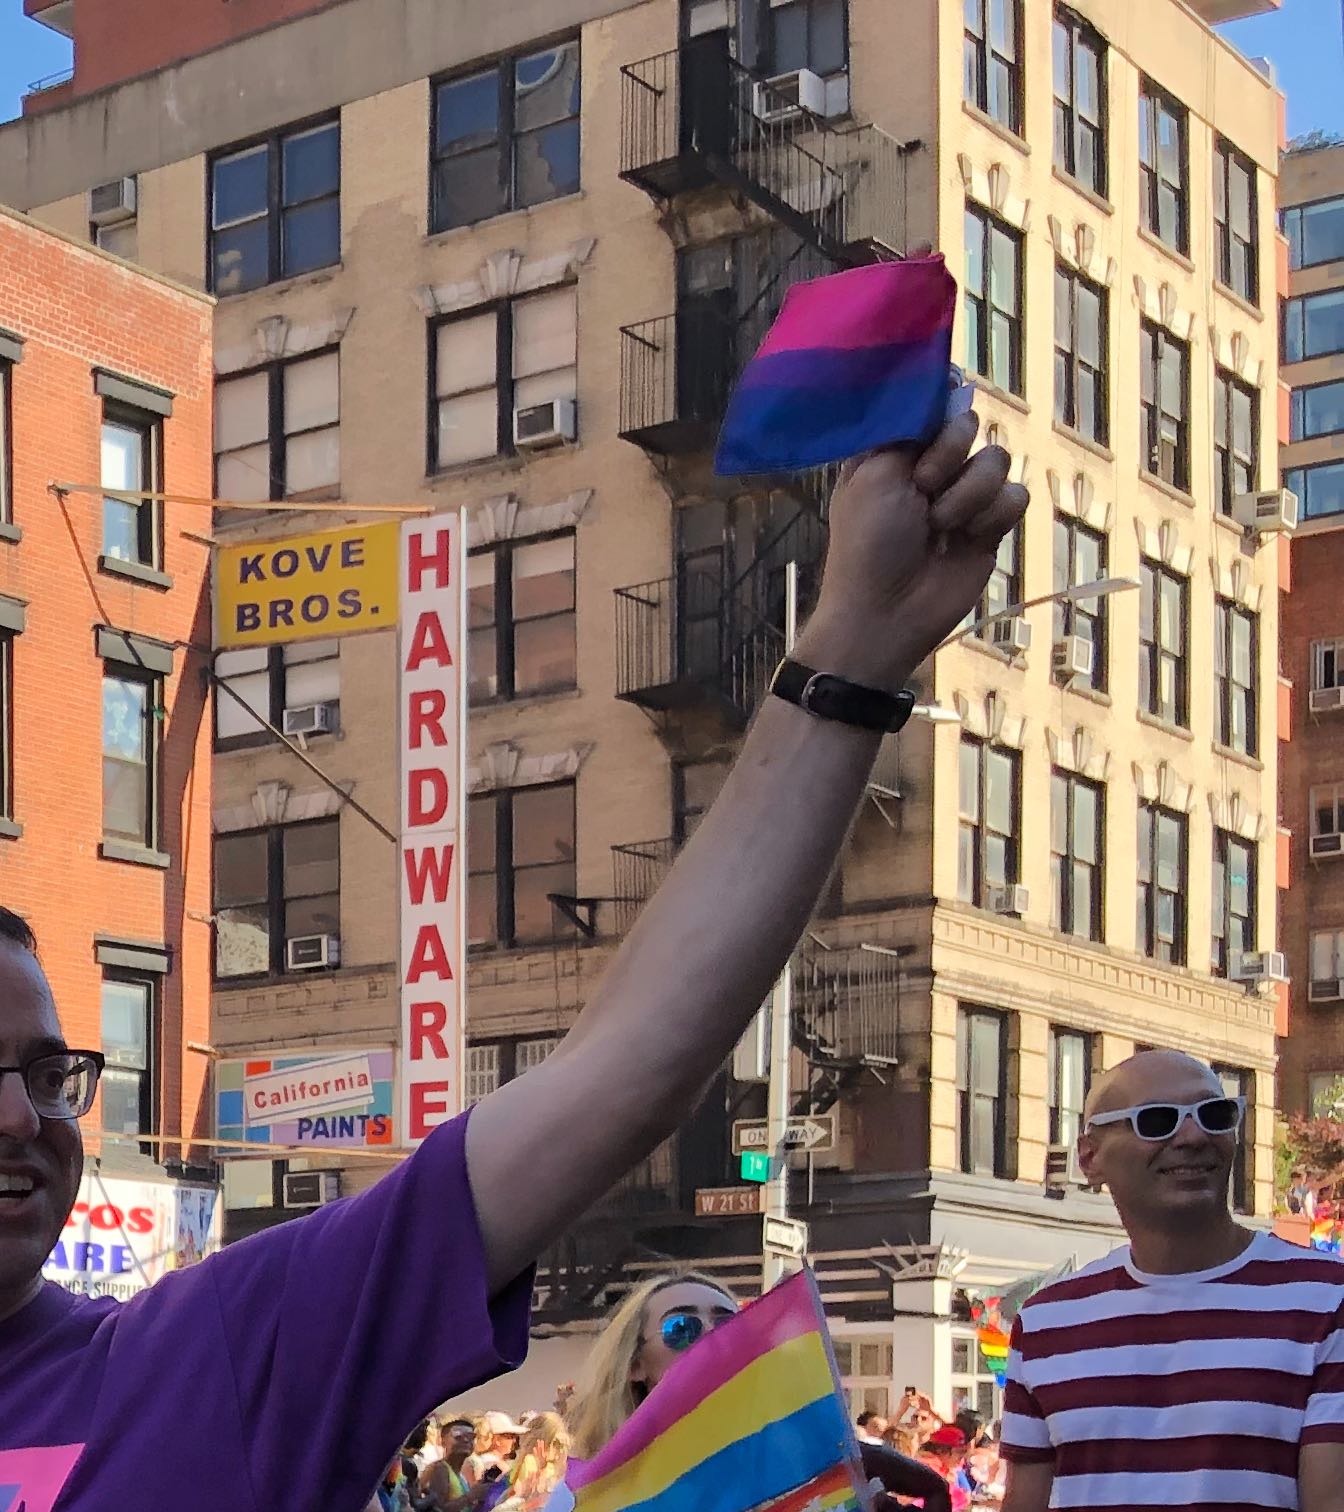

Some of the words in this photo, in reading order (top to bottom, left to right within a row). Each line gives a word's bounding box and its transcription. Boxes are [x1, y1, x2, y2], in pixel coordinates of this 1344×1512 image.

[239, 538, 365, 584] KOVE
[236, 589, 379, 633] BROS.
[404, 528, 454, 1140] HARDWARE
[254, 1072, 369, 1109] California
[297, 1113, 387, 1140] PAINTS
[701, 1195, 714, 1212] W
[720, 1193, 734, 1212] 21
[739, 1192, 754, 1211] St
